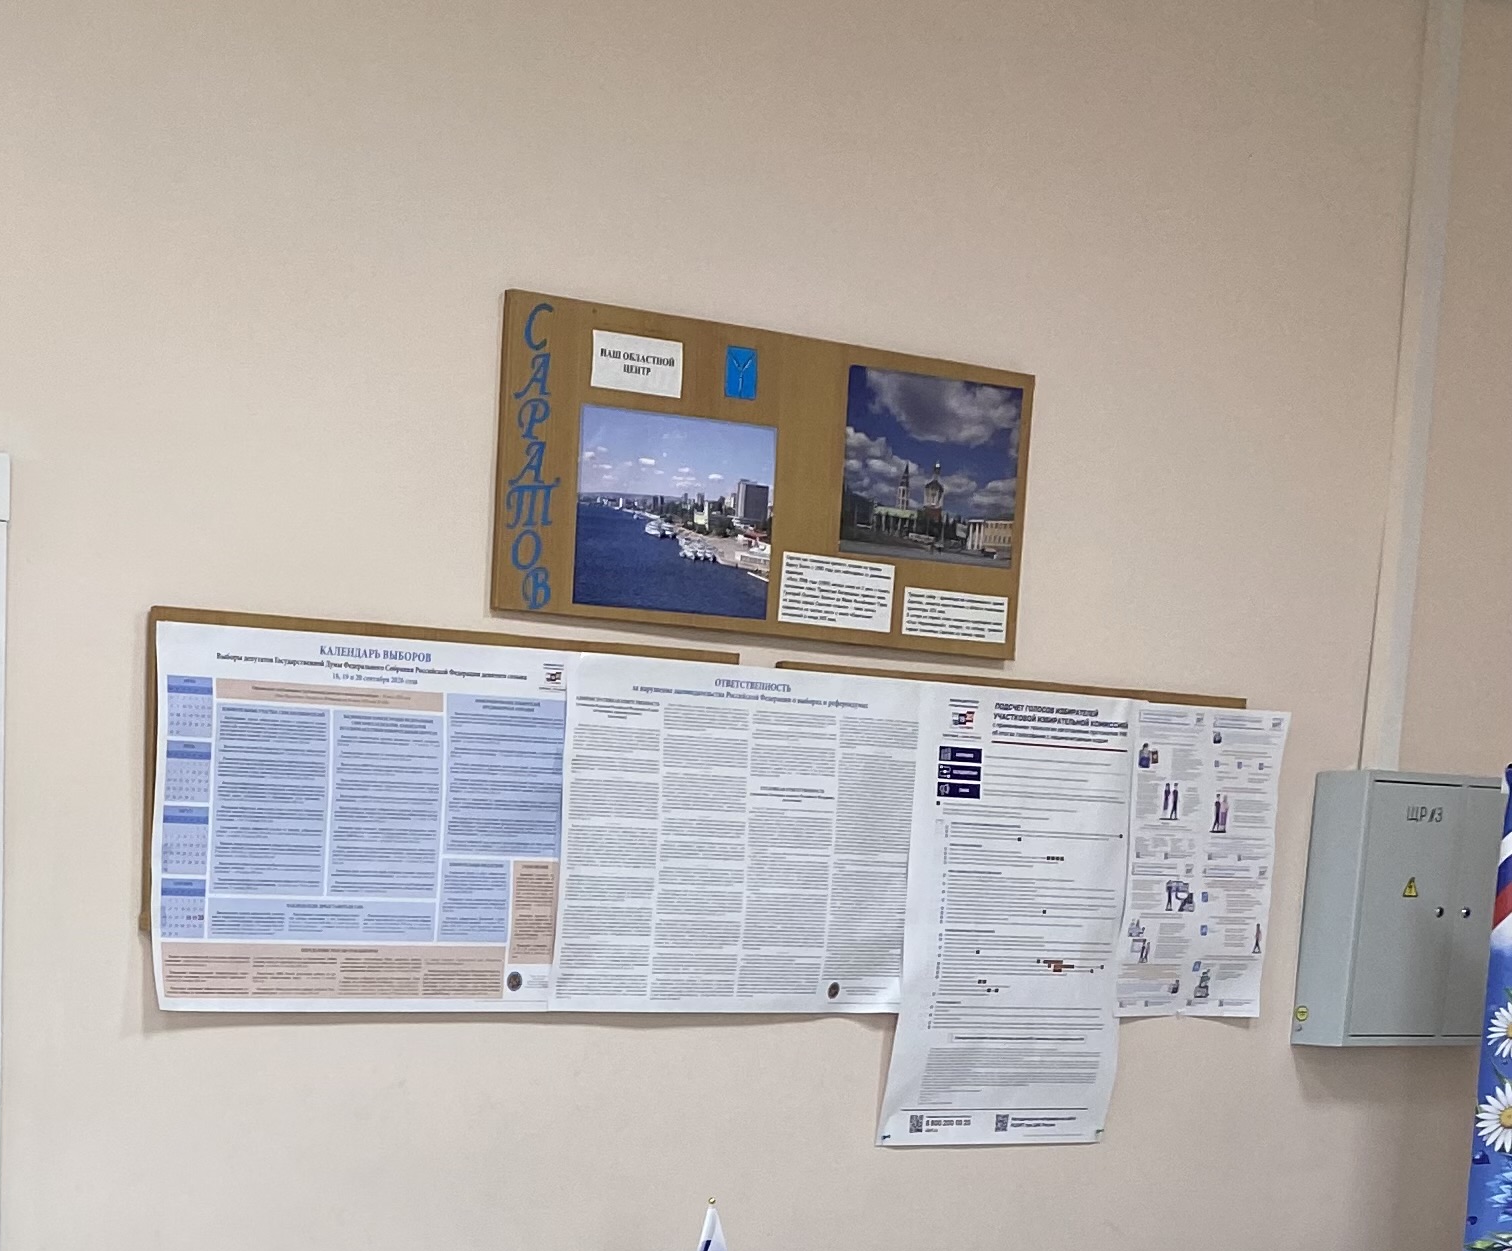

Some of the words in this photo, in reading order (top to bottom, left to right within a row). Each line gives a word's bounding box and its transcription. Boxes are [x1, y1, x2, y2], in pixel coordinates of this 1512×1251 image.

[600, 347, 621, 359] НАШ
[622, 351, 675, 367] ОБЛАСТНОЙ
[623, 363, 651, 376] ЦЕНТР
[506, 302, 561, 610] САРАТОВ
[319, 645, 381, 660] КАЛЕНДАРЬ
[382, 649, 432, 663] ВЫБОРОВ
[714, 678, 792, 693] ОТВЕТСТВЕННОСТЬ
